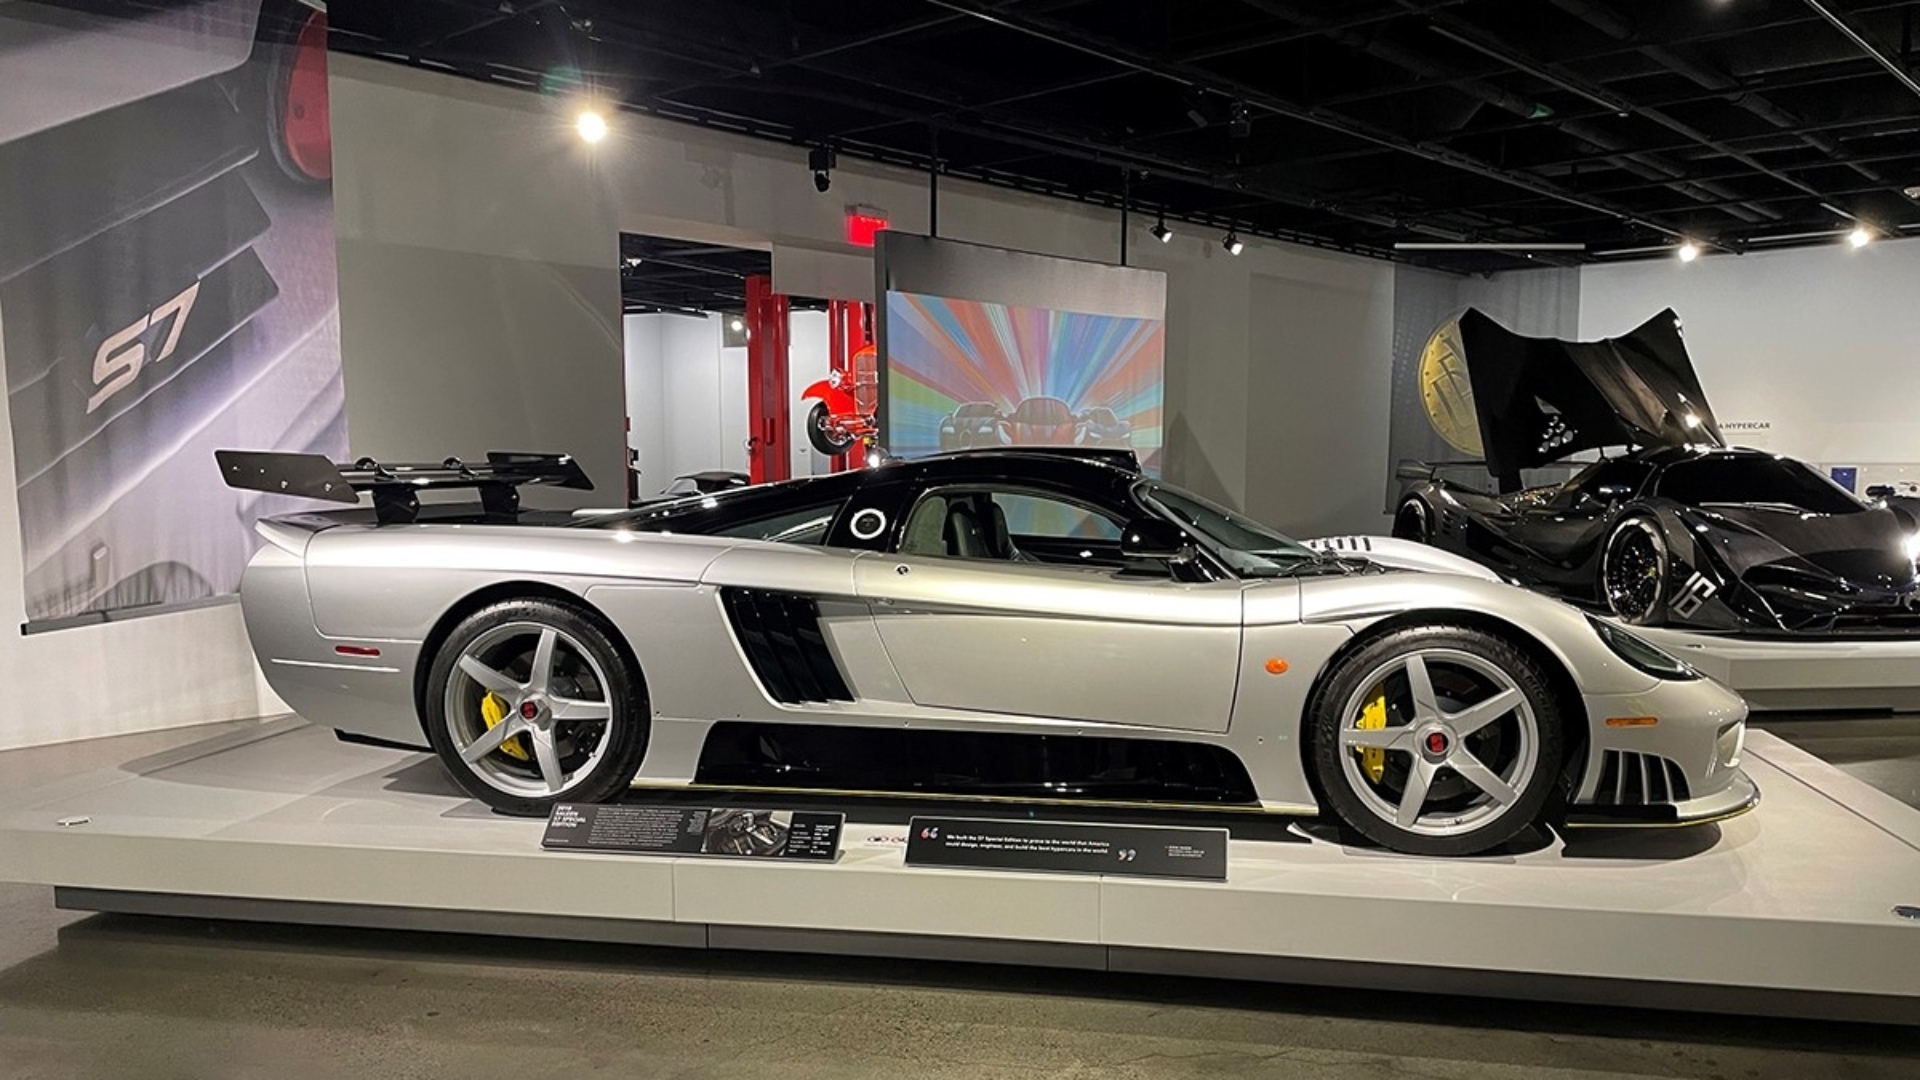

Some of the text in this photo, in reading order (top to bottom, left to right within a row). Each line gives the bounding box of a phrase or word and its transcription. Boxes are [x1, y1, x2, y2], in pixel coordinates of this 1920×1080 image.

[86, 281, 200, 414] S7
[1725, 422, 1770, 430] HYPERCAR
[1668, 571, 1717, 619] 16
